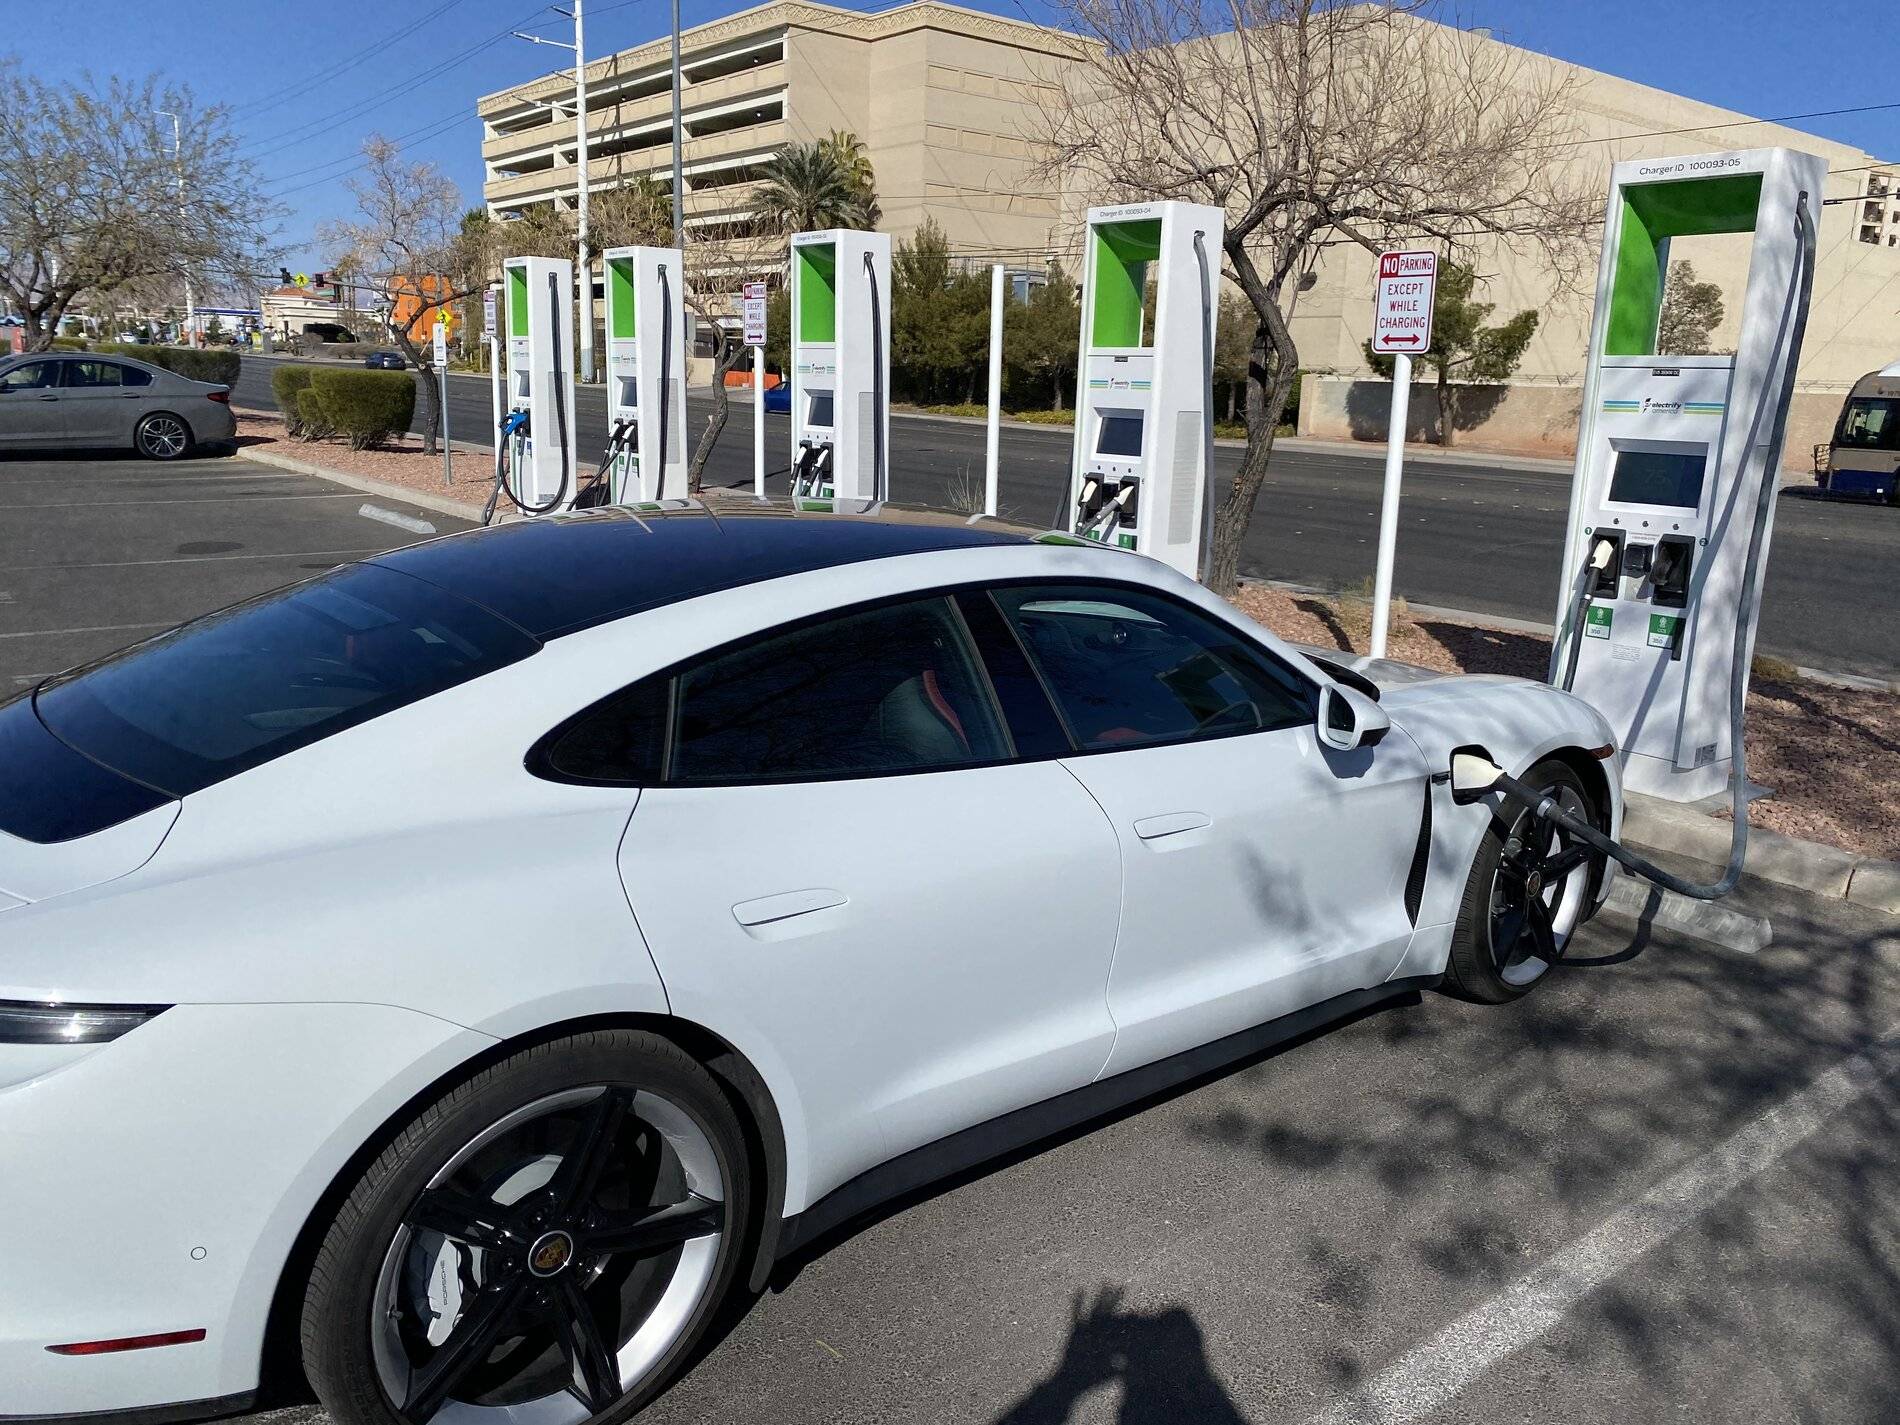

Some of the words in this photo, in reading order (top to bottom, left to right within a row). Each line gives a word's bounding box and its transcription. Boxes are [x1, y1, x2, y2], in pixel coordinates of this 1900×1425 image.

[1639, 165, 1673, 175] Charger
[1675, 163, 1685, 172] ID
[1689, 158, 1741, 170] 100093-05
[1383, 258, 1398, 274] NO
[1400, 257, 1432, 271] PARKING
[1388, 283, 1424, 295] EXCEPT
[1390, 300, 1418, 312] WHILE
[1380, 316, 1425, 329] CHARGING
[440, 1260, 448, 1306] PORSCHE
